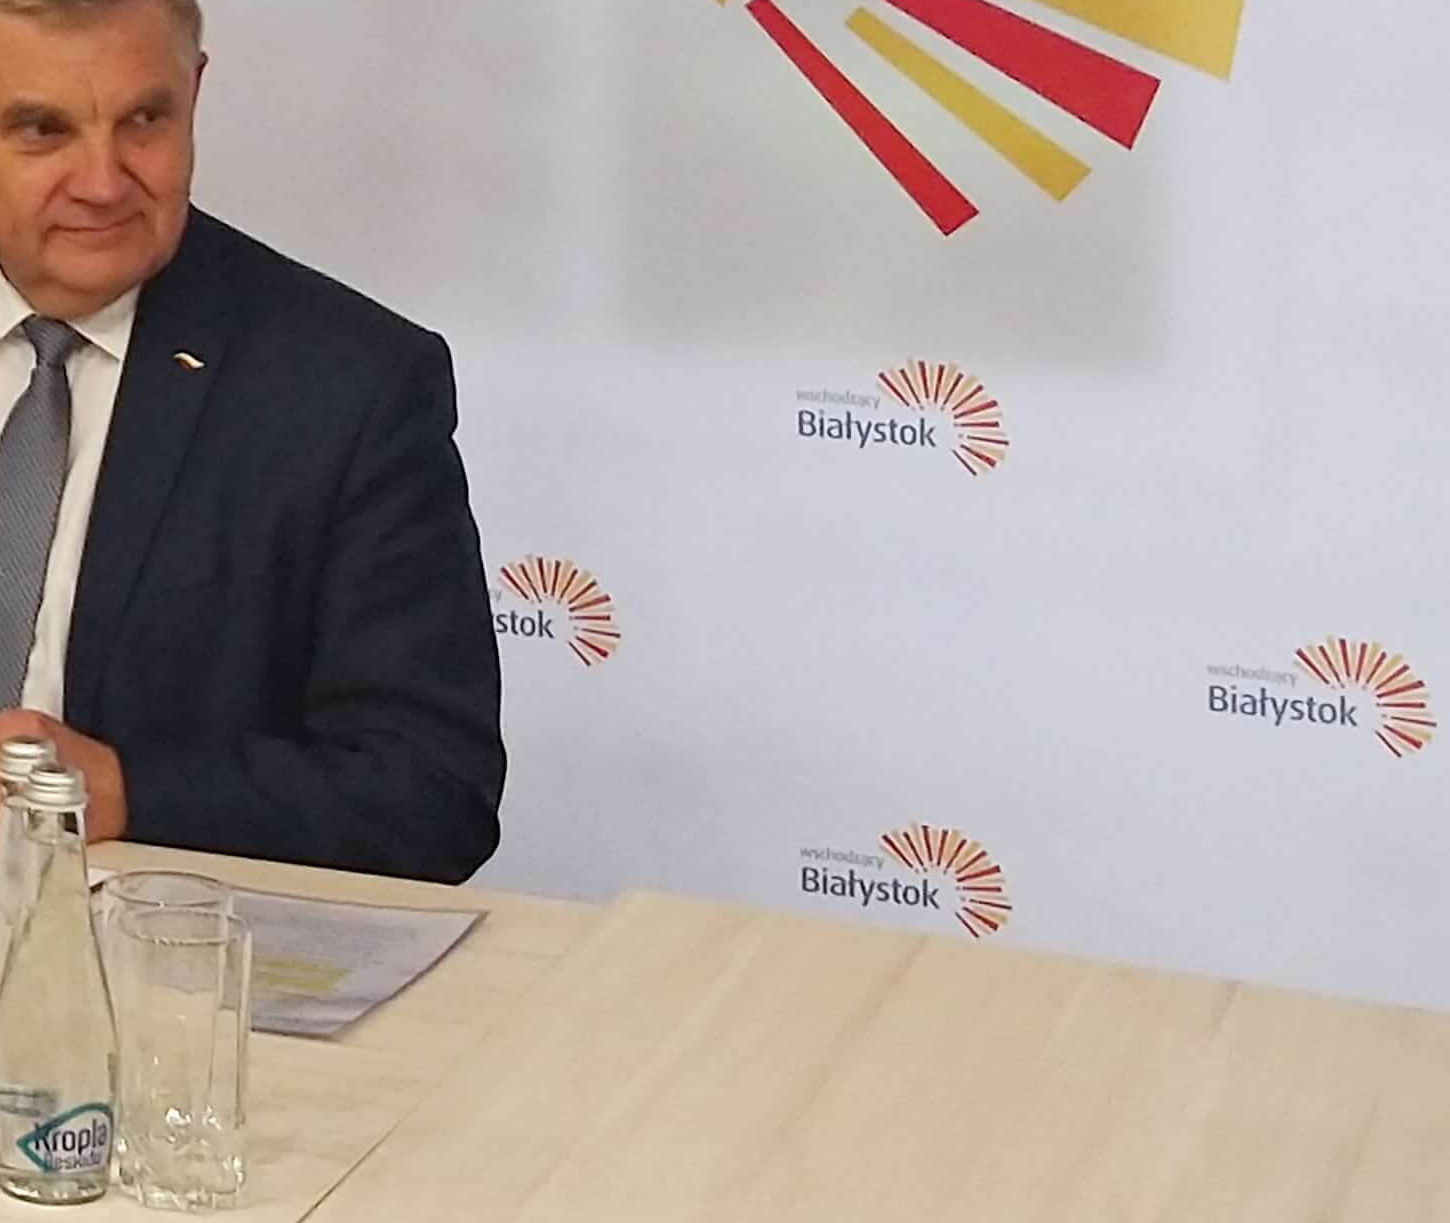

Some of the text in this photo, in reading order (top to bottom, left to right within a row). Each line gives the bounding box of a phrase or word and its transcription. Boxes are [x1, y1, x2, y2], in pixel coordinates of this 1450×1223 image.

[798, 409, 936, 448] Białystok
[1208, 685, 1359, 727] Białystok
[801, 866, 940, 910] Białystok
[35, 1119, 107, 1155] Kropla
